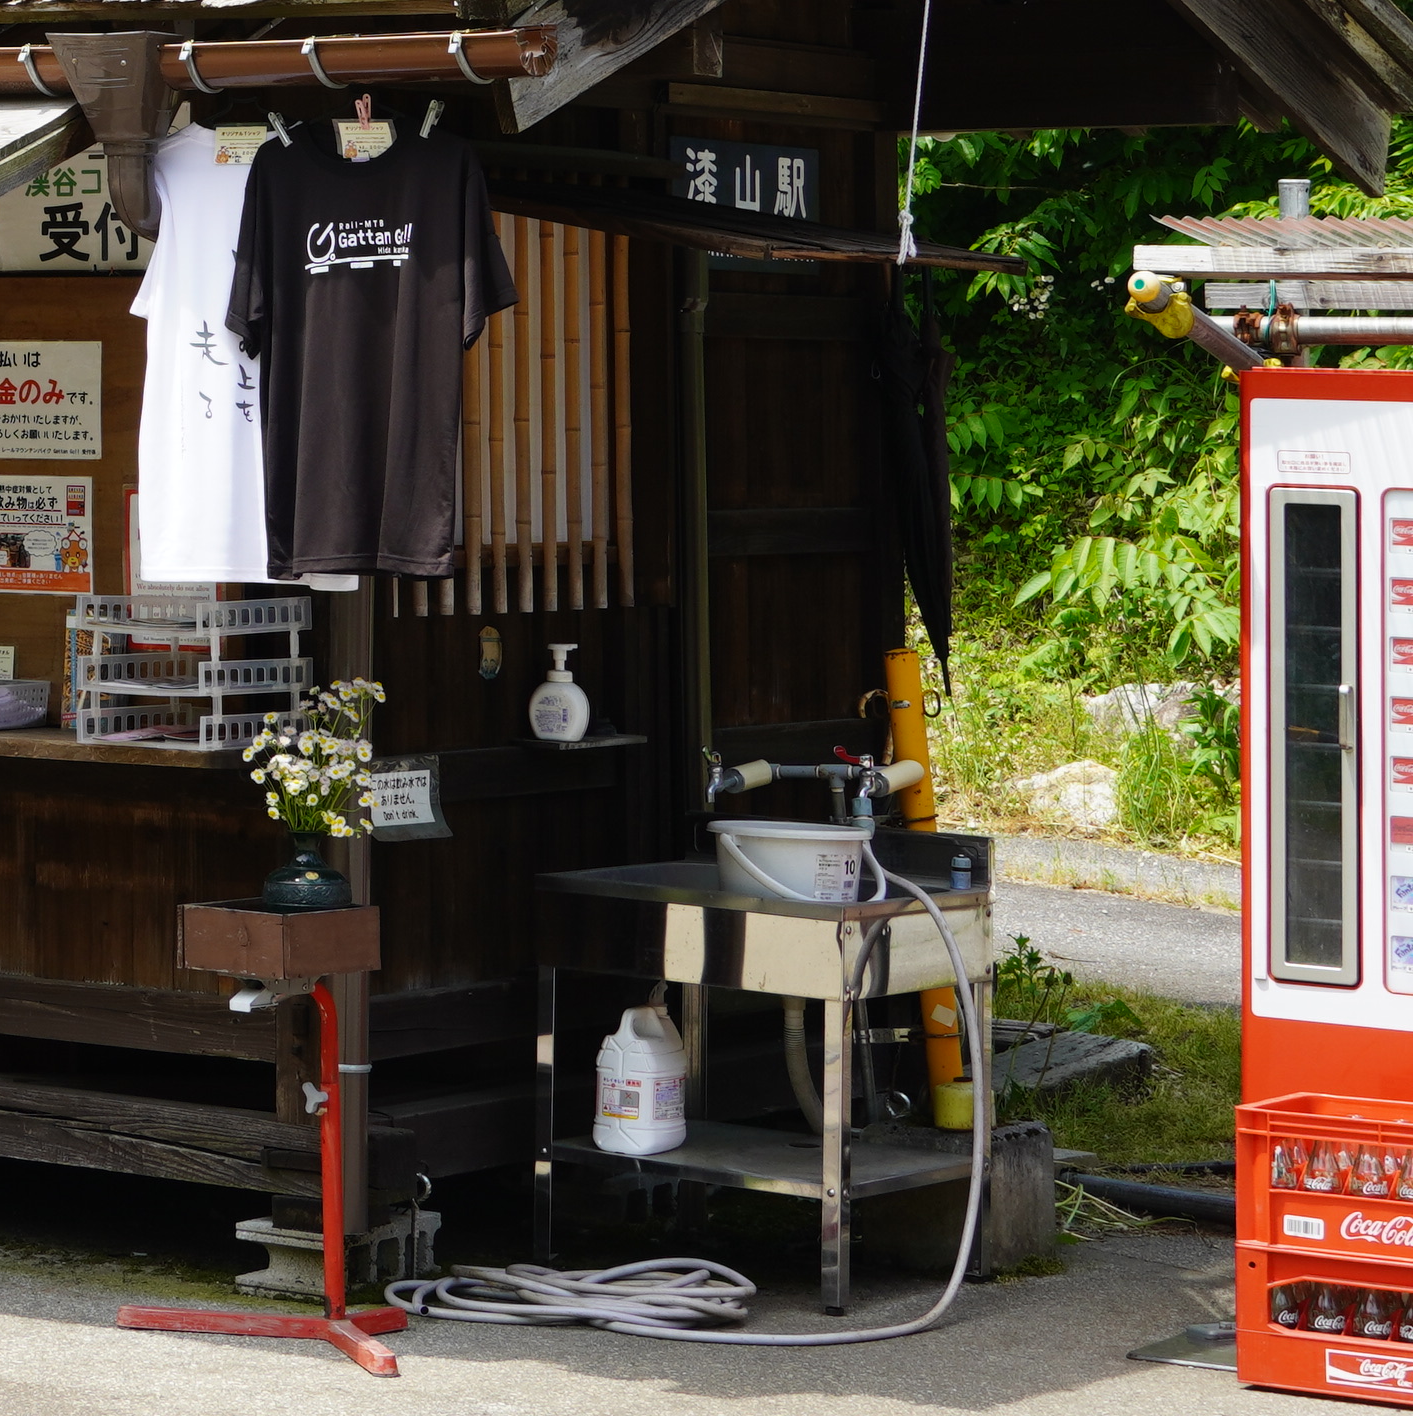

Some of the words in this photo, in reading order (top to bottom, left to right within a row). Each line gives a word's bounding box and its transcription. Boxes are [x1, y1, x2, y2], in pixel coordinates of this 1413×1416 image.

[685, 146, 807, 220] 漆山駅
[39, 201, 139, 262] 受付
[338, 229, 391, 248] Gattan
[189, 320, 229, 419] 走る
[0, 485, 52, 495] 熱中症対策として
[844, 860, 856, 875] 10
